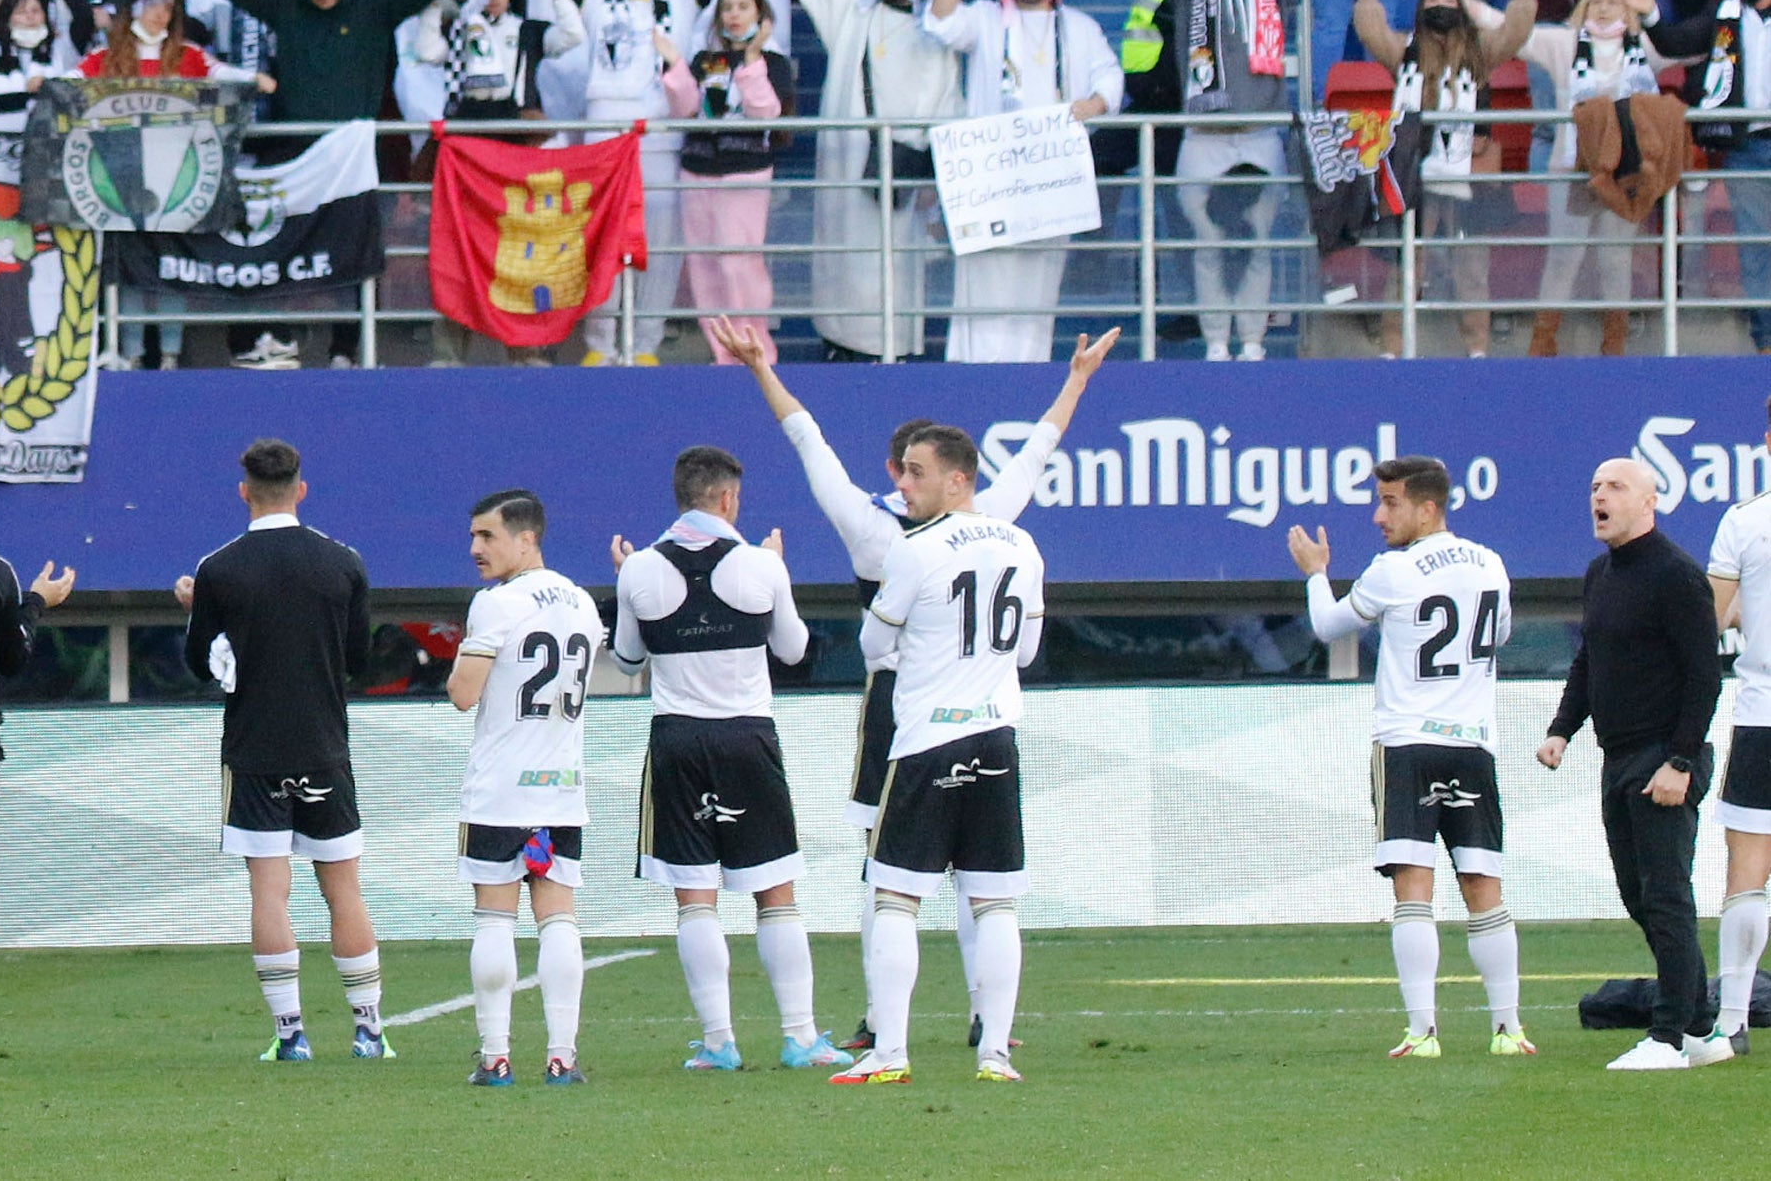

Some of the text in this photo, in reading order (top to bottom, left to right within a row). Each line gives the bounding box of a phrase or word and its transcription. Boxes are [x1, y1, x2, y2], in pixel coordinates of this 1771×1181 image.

[110, 96, 168, 114] CLUB
[67, 139, 111, 229] BURGOS
[942, 136, 1087, 183] 30 CAMELLOS
[158, 252, 333, 288] BURGOS C.F.
[676, 623, 733, 638] CATAPULT
[947, 567, 1023, 660] 16
[1414, 590, 1500, 682] 24
[516, 631, 591, 723] 23
